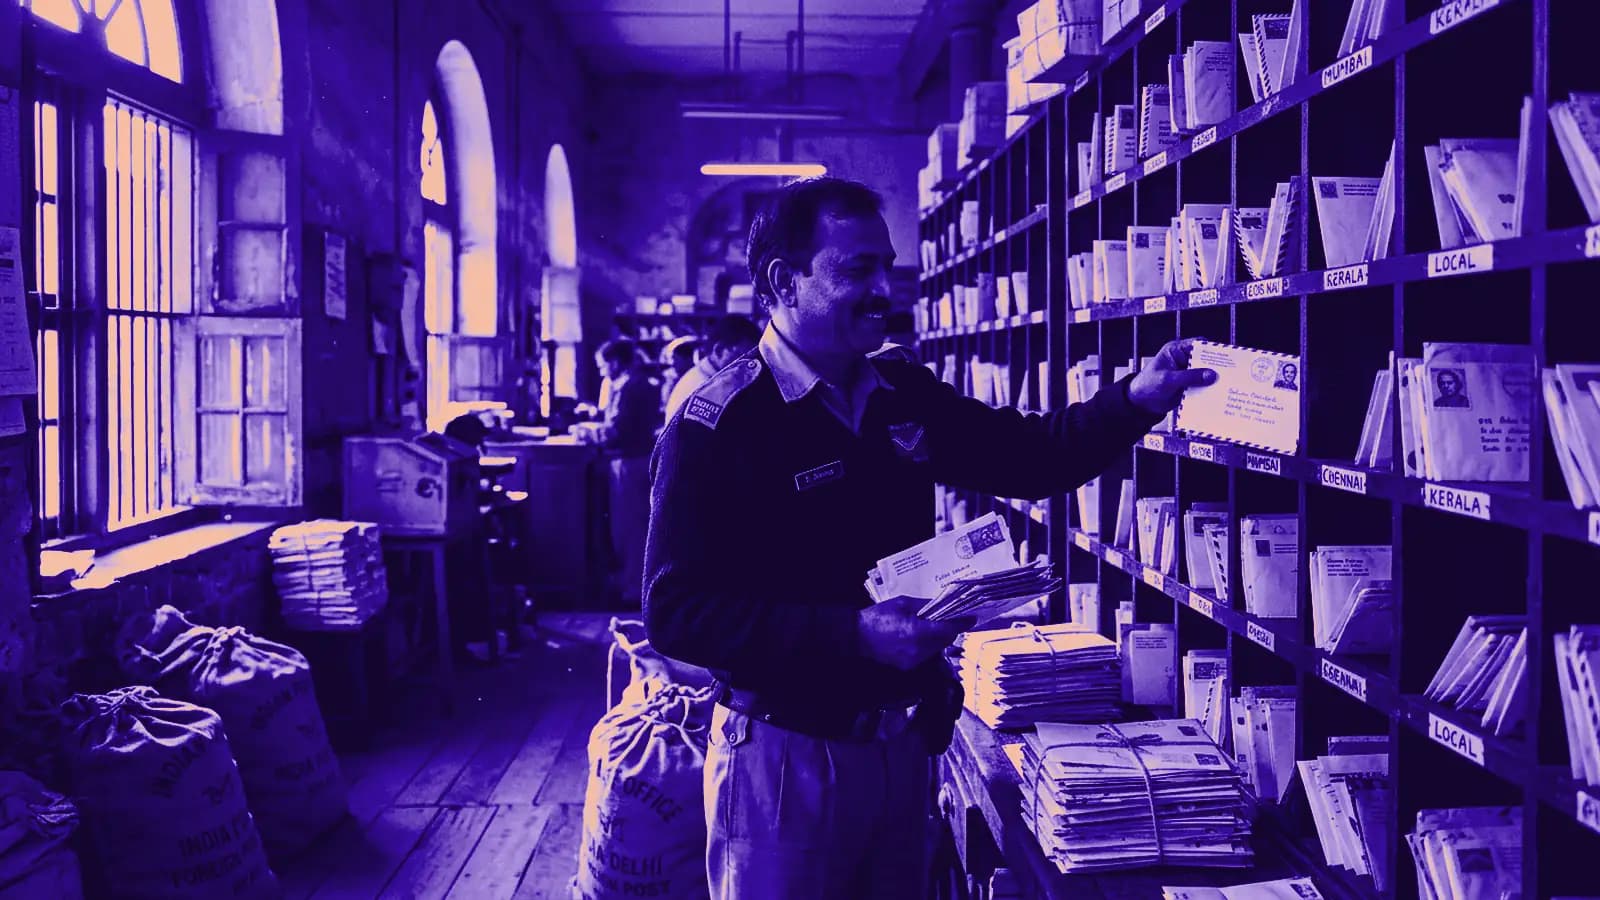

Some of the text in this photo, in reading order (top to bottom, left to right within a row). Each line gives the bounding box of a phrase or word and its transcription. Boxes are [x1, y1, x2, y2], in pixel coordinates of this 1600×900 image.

[1435, 0, 1486, 30] KERAL
[1323, 53, 1368, 85] MUMBAI
[1434, 256, 1477, 274] LOCAL
[1429, 488, 1482, 514] KERALA
[1434, 720, 1478, 759] LOCAL
[623, 879, 672, 897] POST
